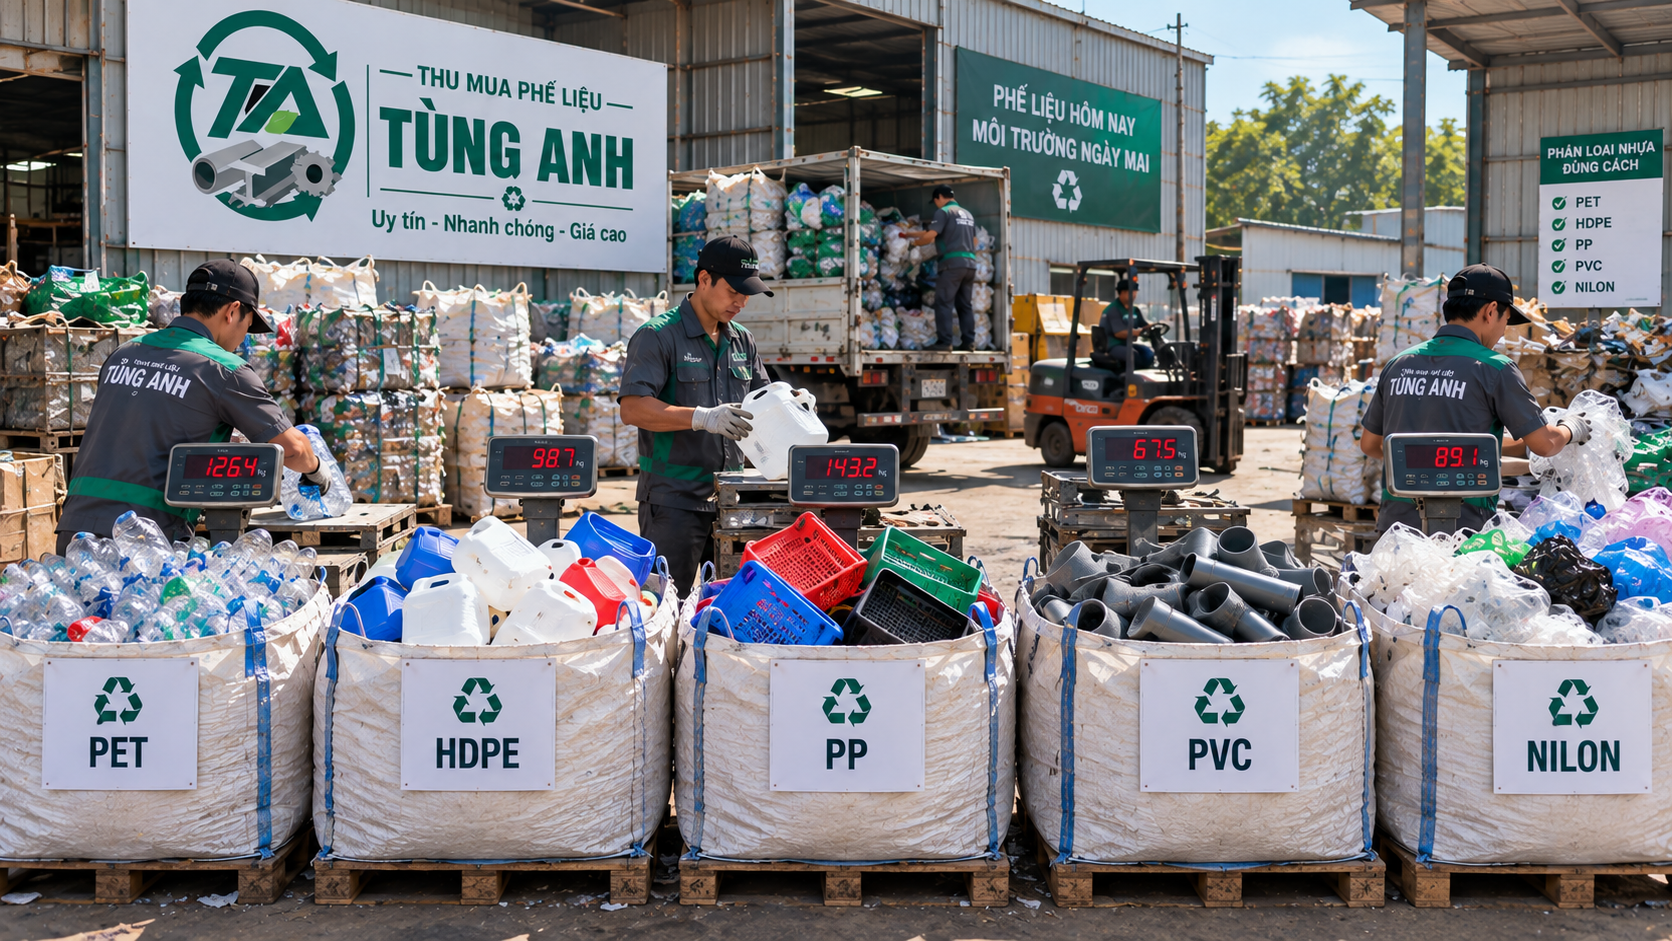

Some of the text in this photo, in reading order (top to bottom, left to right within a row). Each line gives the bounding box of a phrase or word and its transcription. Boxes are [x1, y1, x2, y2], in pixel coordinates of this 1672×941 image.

[207, 56, 330, 139] TA
[417, 65, 602, 114] THU MUA PHẾ LIỆU
[993, 83, 1136, 137] PHẾ LIỆU HÔM NAY
[379, 97, 633, 190] TÙNG ANH
[972, 117, 1150, 174] MÔI TRƯỜNG NGÀY MAI
[1618, 140, 1656, 156] NHỰA
[1602, 157, 1639, 172] CÁCH
[1576, 196, 1601, 208] PET
[371, 209, 397, 233] Uy
[402, 211, 426, 230] tín
[444, 214, 499, 235] Nhanh
[505, 218, 554, 243] chóng
[570, 222, 596, 240] Giá
[600, 228, 627, 243] cao
[1576, 217, 1612, 229] HDPE
[1576, 239, 1593, 250] PP
[1575, 260, 1603, 272] PVC
[1575, 281, 1615, 293] NILON
[145, 370, 191, 399] ANH
[1428, 377, 1467, 400] ANH
[531, 447, 576, 469] 98.7
[1133, 438, 1176, 460] 67.5
[1434, 446, 1478, 468] 89.1
[205, 456, 258, 478] 126.4
[826, 457, 877, 478] 143.2
[89, 736, 148, 768] PET
[436, 737, 520, 769] HDPE
[825, 738, 868, 770] PP
[1188, 737, 1252, 771] PVC
[1527, 739, 1620, 772] NILON
